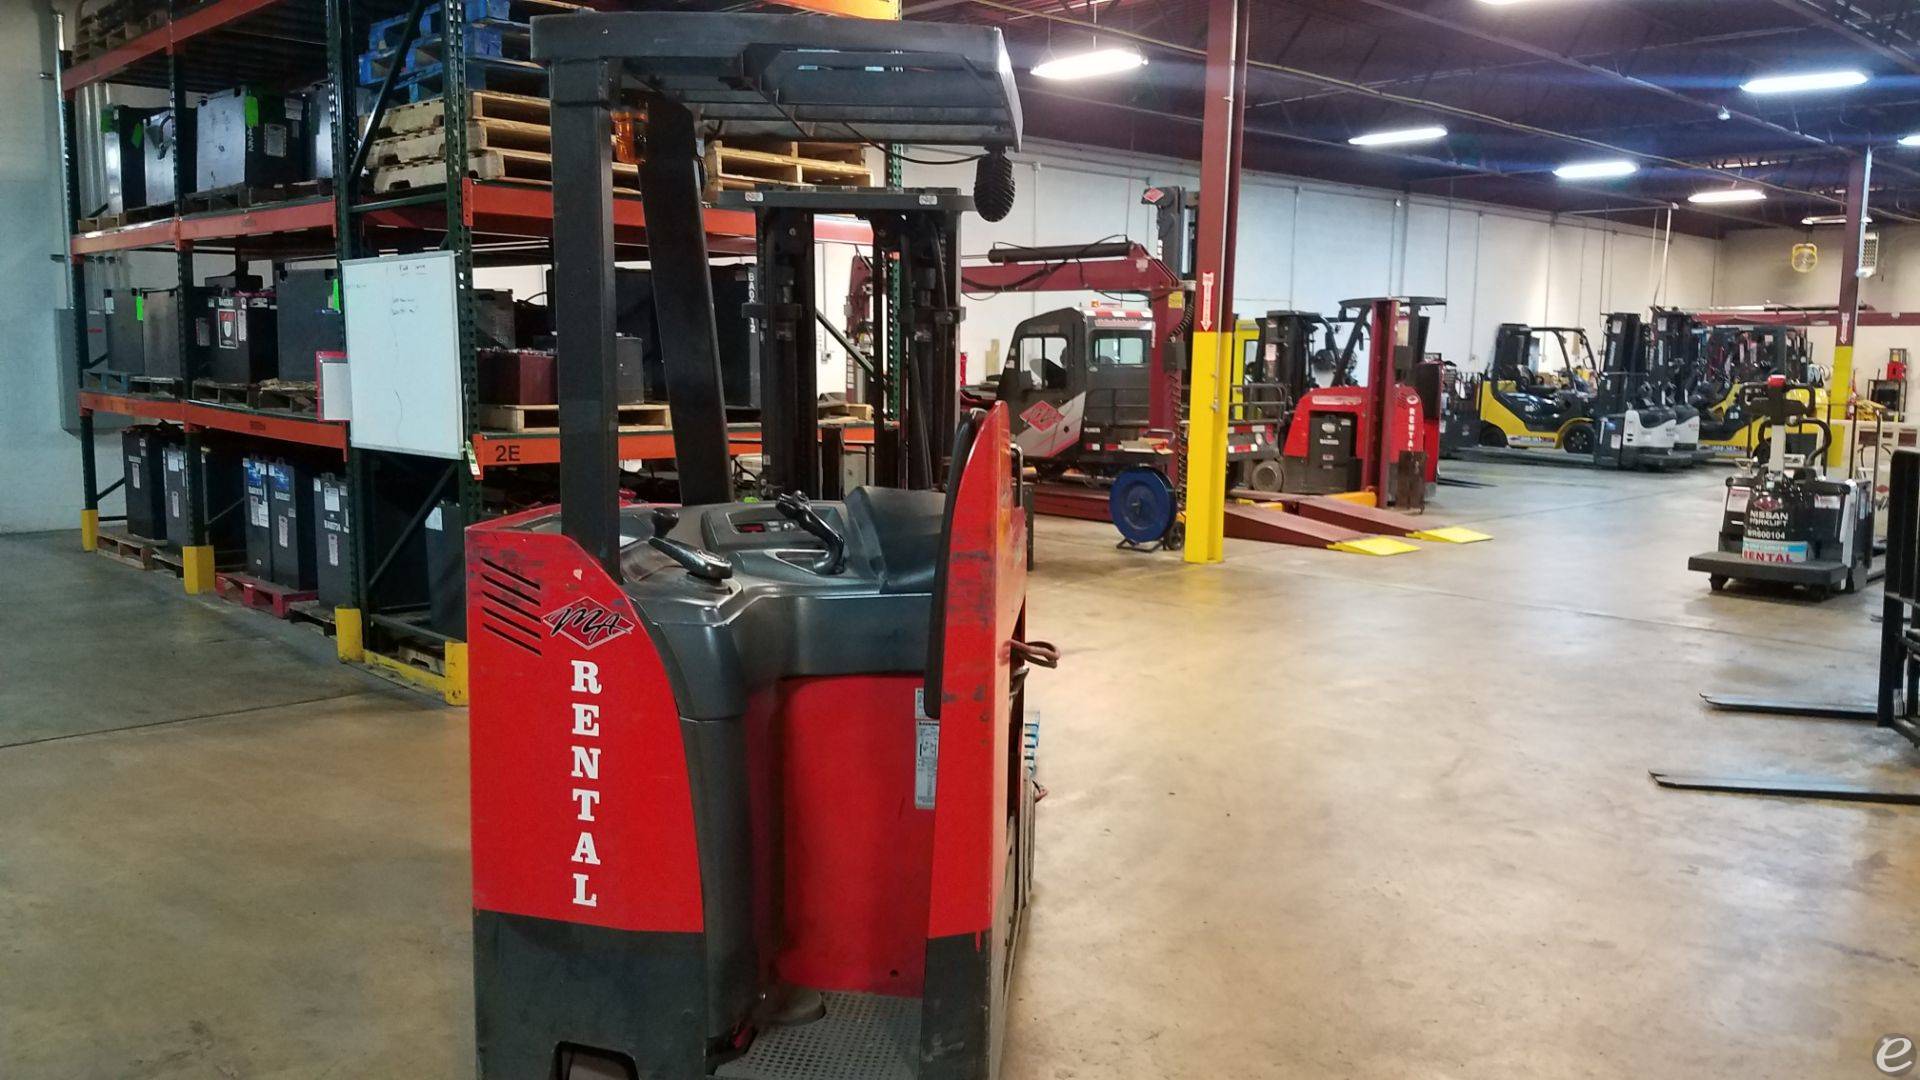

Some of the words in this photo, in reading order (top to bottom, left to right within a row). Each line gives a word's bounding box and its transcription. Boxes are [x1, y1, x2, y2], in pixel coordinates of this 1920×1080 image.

[1407, 407, 1416, 451] RENTA
[496, 445, 520, 462] 2E
[1750, 510, 1789, 520] NISSAN
[571, 659, 602, 907] RENTAL
